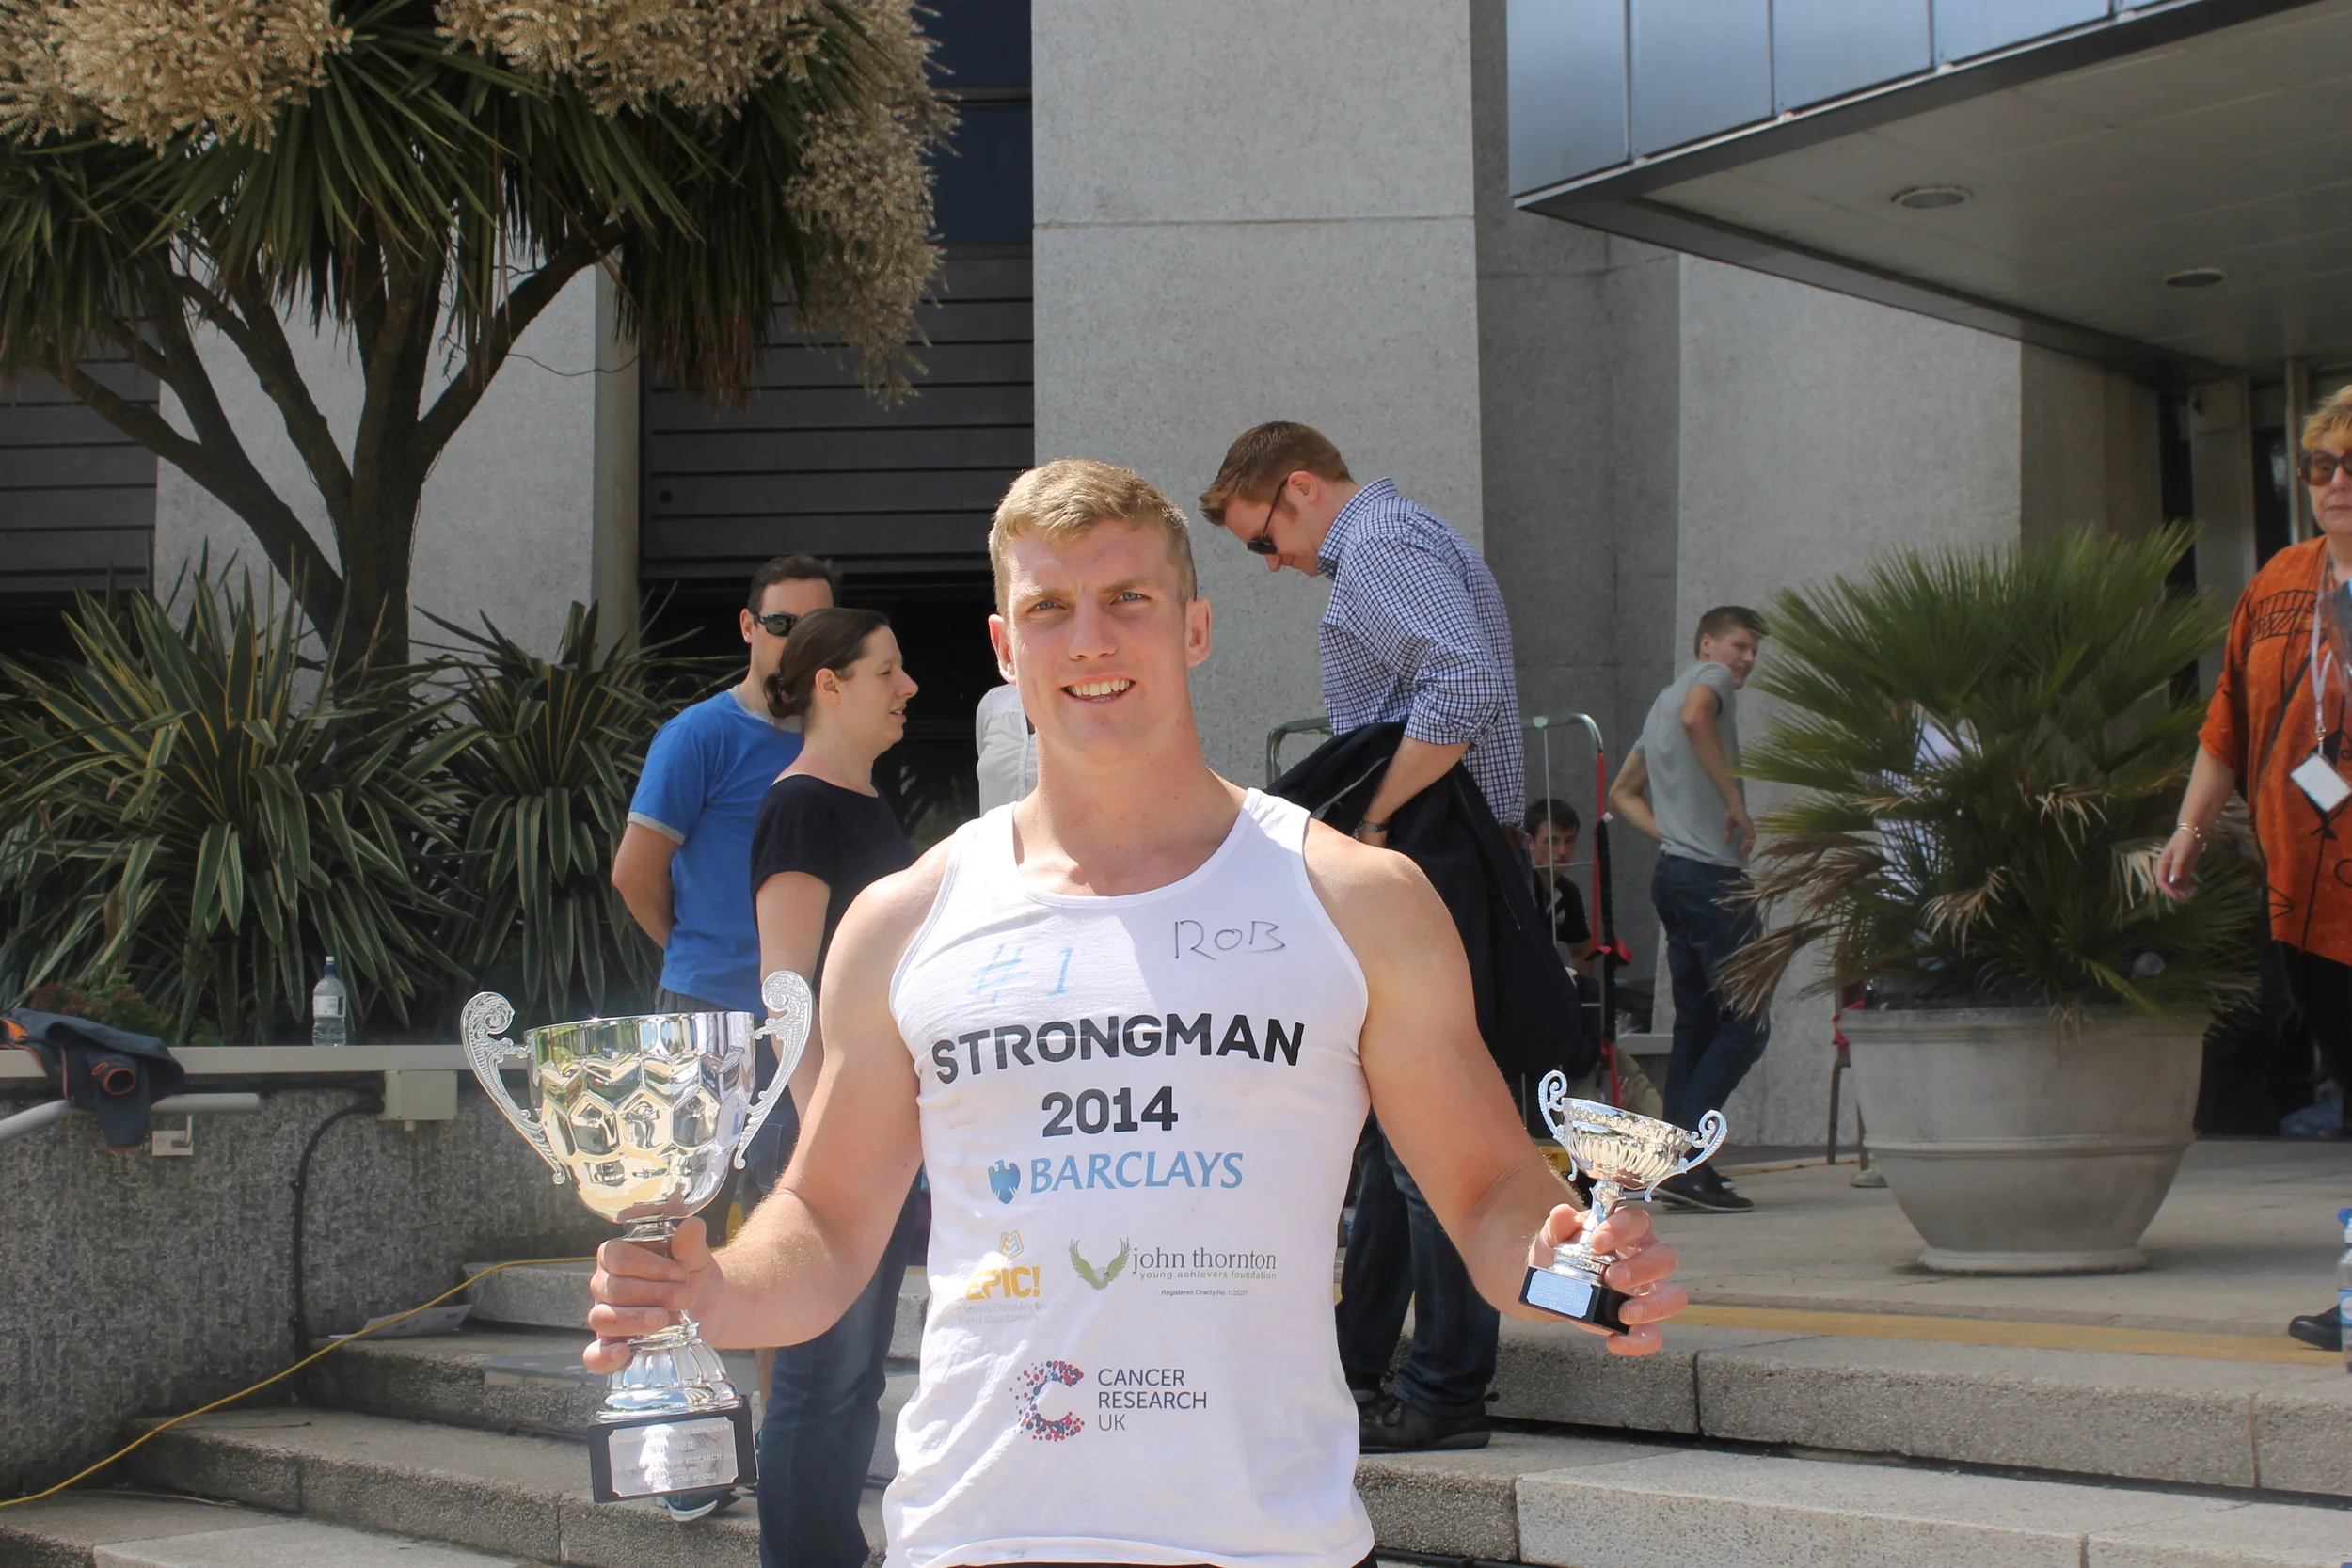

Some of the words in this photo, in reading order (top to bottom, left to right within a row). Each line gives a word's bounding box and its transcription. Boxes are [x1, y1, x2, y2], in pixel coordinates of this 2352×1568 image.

[930, 1012, 1305, 1085] STRONGMAN
[1041, 1085, 1179, 1138] 2014
[1029, 1150, 1245, 1194] BARCLAYS
[1132, 1246, 1185, 1275] john
[1193, 1246, 1278, 1270] thornton
[965, 1265, 1041, 1302] EPIC!
[1139, 1270, 1173, 1280] young
[1177, 1270, 1228, 1279] achievers
[1231, 1269, 1278, 1280] foundation
[1161, 1289, 1194, 1297] Registered
[1097, 1368, 1185, 1387] CANCER
[1098, 1390, 1208, 1410] RESEARCH
[1098, 1413, 1127, 1432] UK
